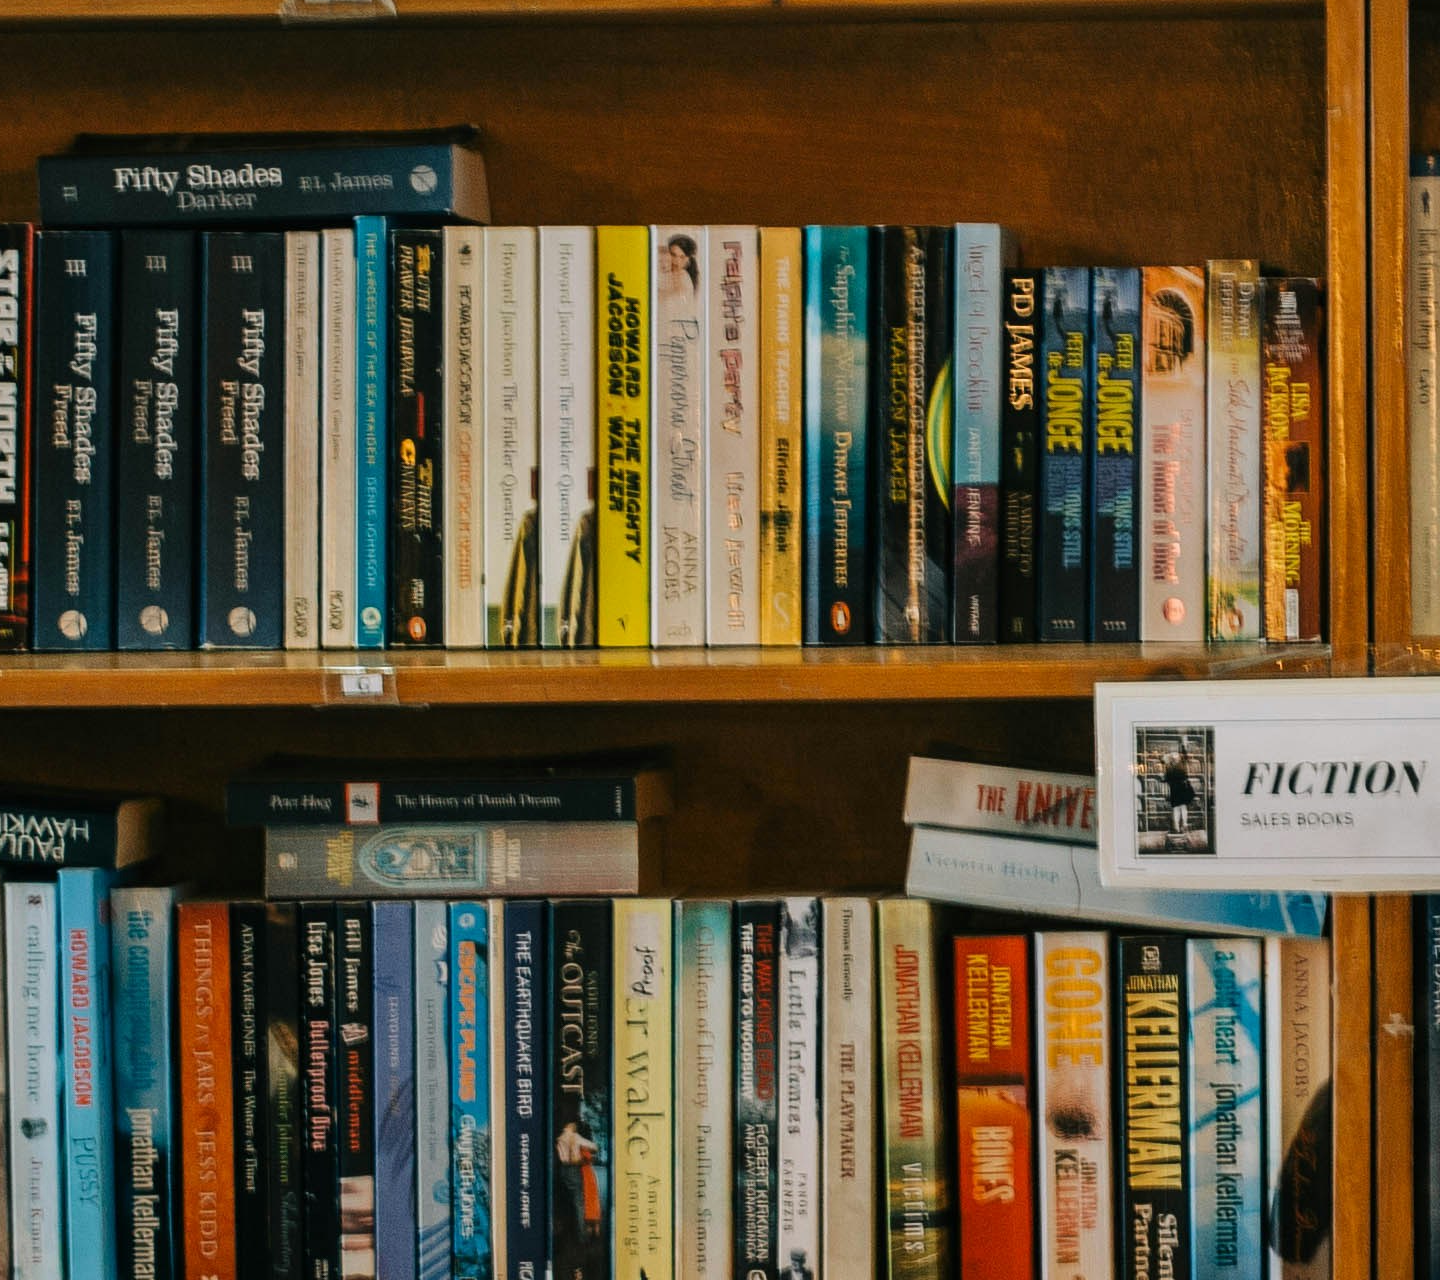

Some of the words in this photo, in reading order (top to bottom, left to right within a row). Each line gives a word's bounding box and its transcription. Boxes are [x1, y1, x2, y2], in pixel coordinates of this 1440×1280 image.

[112, 167, 178, 196] Fifty
[185, 163, 282, 189] Shades
[177, 190, 257, 212] Darker
[608, 273, 624, 398] JACOBSON
[1010, 278, 1034, 314] PD
[624, 298, 641, 399] HOWARD
[1005, 320, 1034, 411] JAMES
[610, 417, 626, 513] WALZER
[624, 420, 642, 463] THE
[626, 470, 642, 564] MIGHTY
[1241, 814, 1290, 826] SALES
[1297, 814, 1353, 825] BOOKS
[1242, 761, 1427, 795] FICTION
[1047, 948, 1106, 1065] GONE
[1127, 992, 1179, 1189] KELLERMAN
[972, 1126, 1014, 1203] BONES
